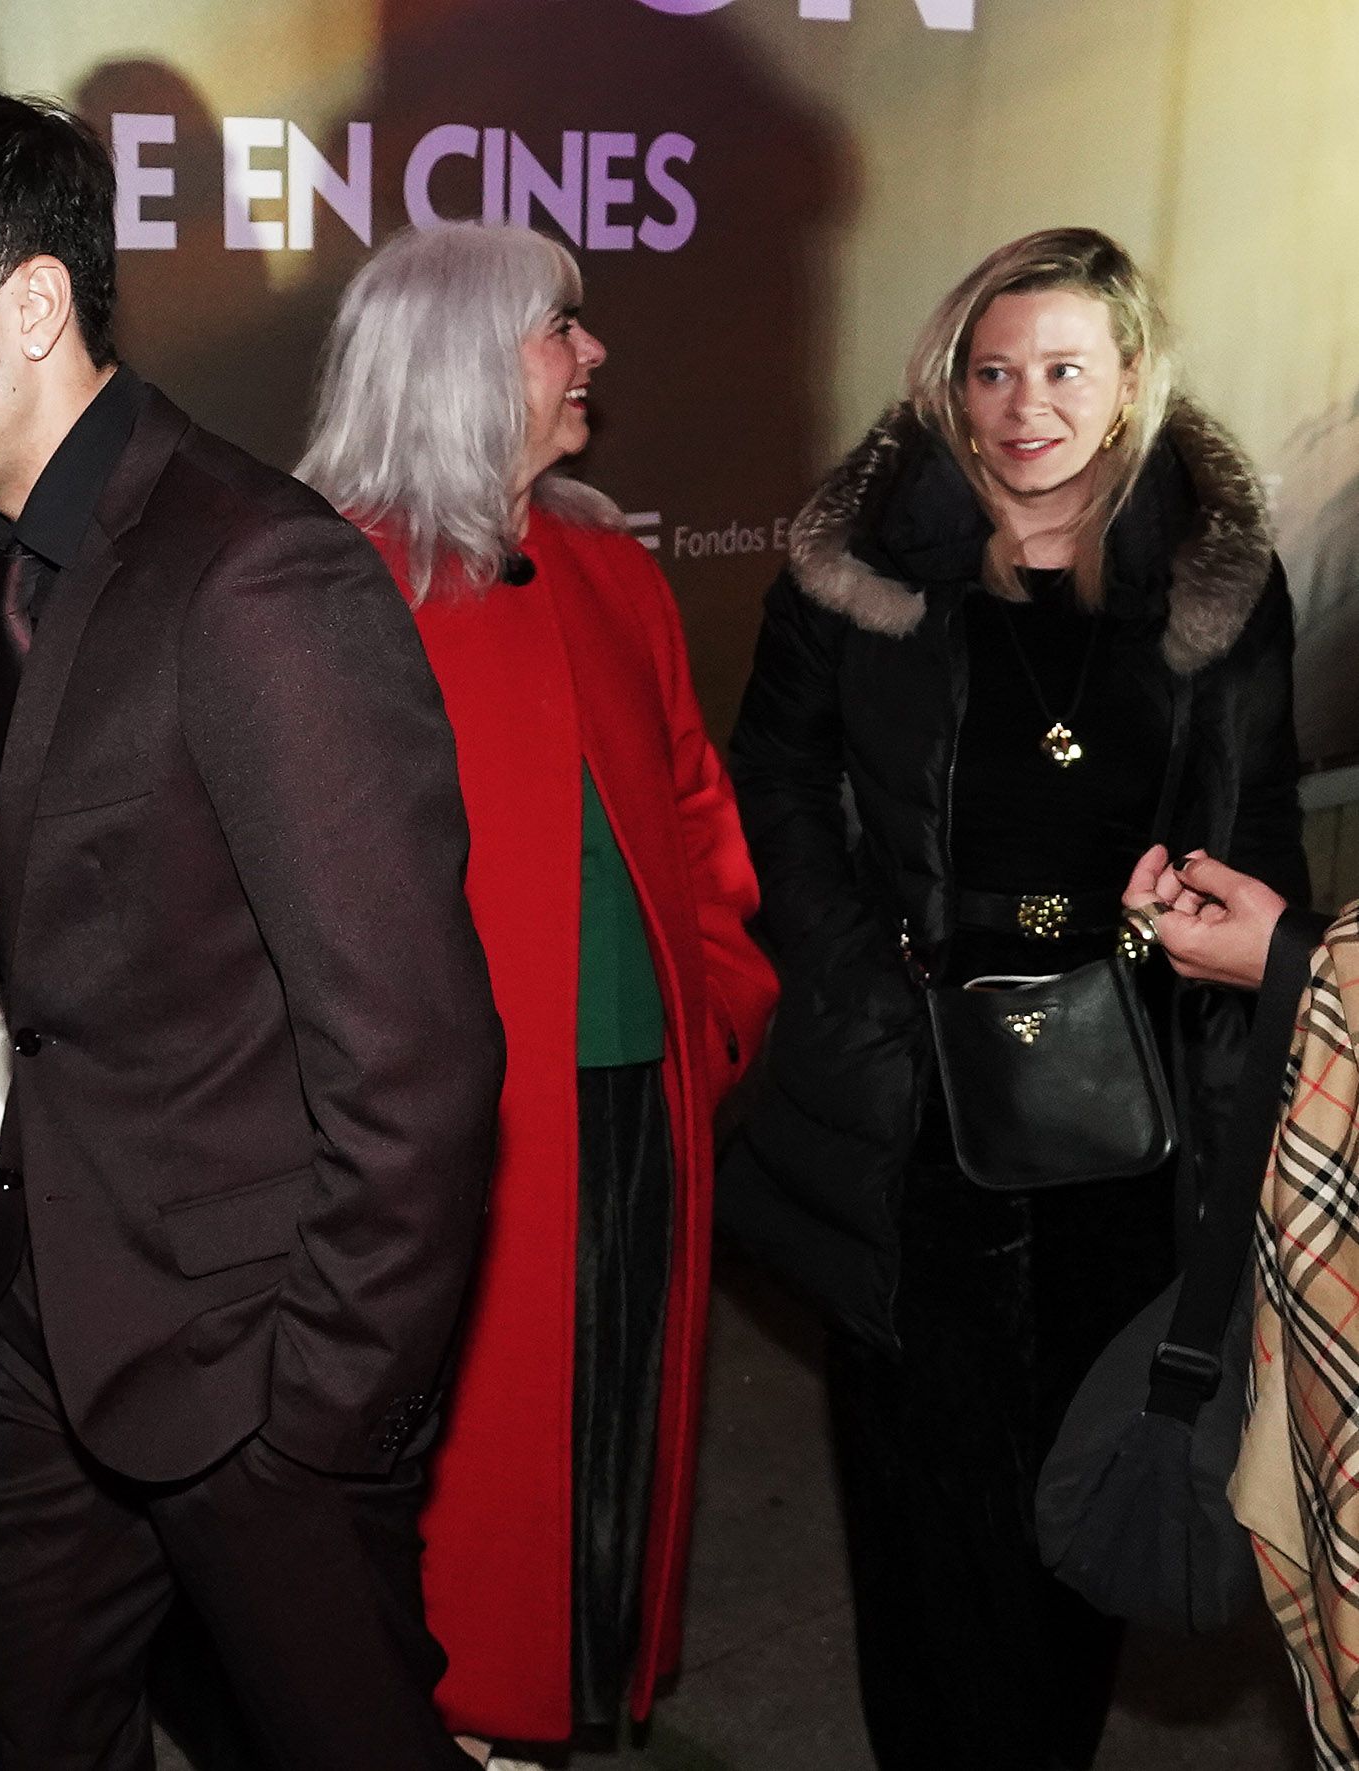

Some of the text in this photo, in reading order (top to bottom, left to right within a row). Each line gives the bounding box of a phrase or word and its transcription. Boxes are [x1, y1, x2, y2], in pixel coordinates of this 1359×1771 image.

[223, 116, 372, 251] EN
[404, 123, 698, 252] CINES
[674, 519, 765, 558] Fondos
